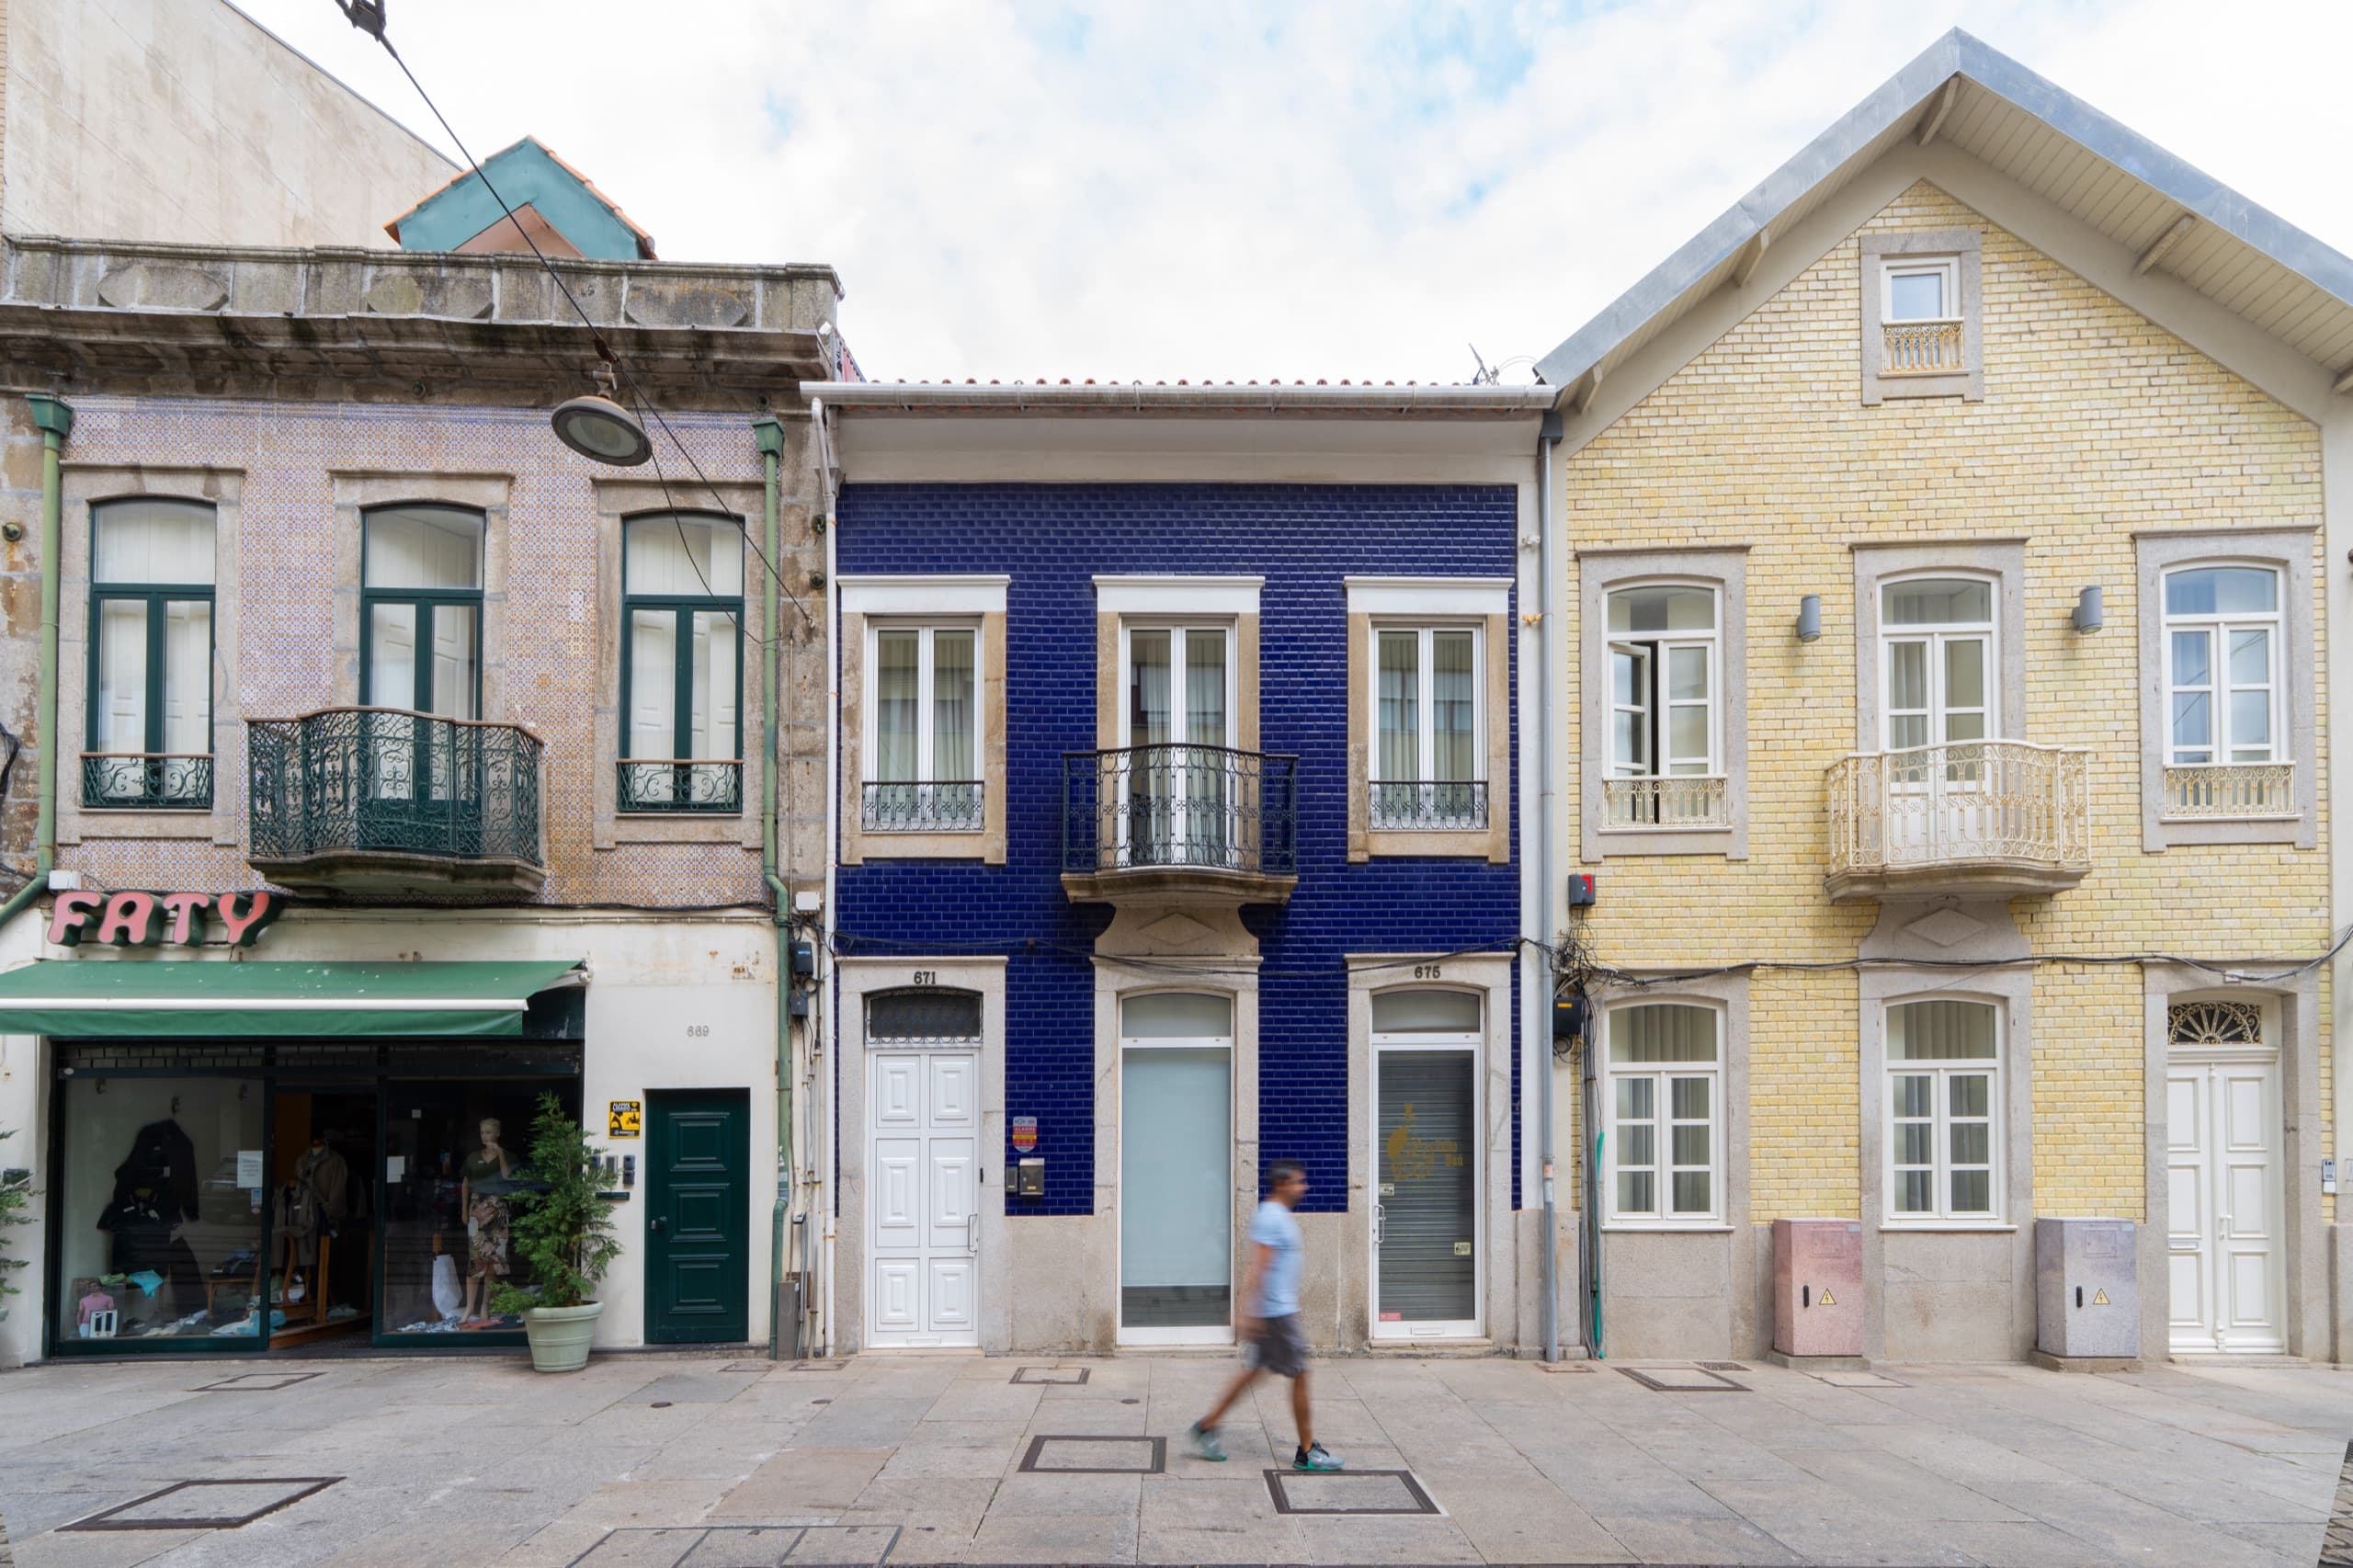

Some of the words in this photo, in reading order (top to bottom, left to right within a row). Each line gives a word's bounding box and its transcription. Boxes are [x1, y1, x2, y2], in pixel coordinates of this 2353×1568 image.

[48, 892, 270, 944] FATY
[914, 971, 936, 984] 671
[1415, 966, 1441, 979] 675
[687, 1025, 710, 1038] 669
